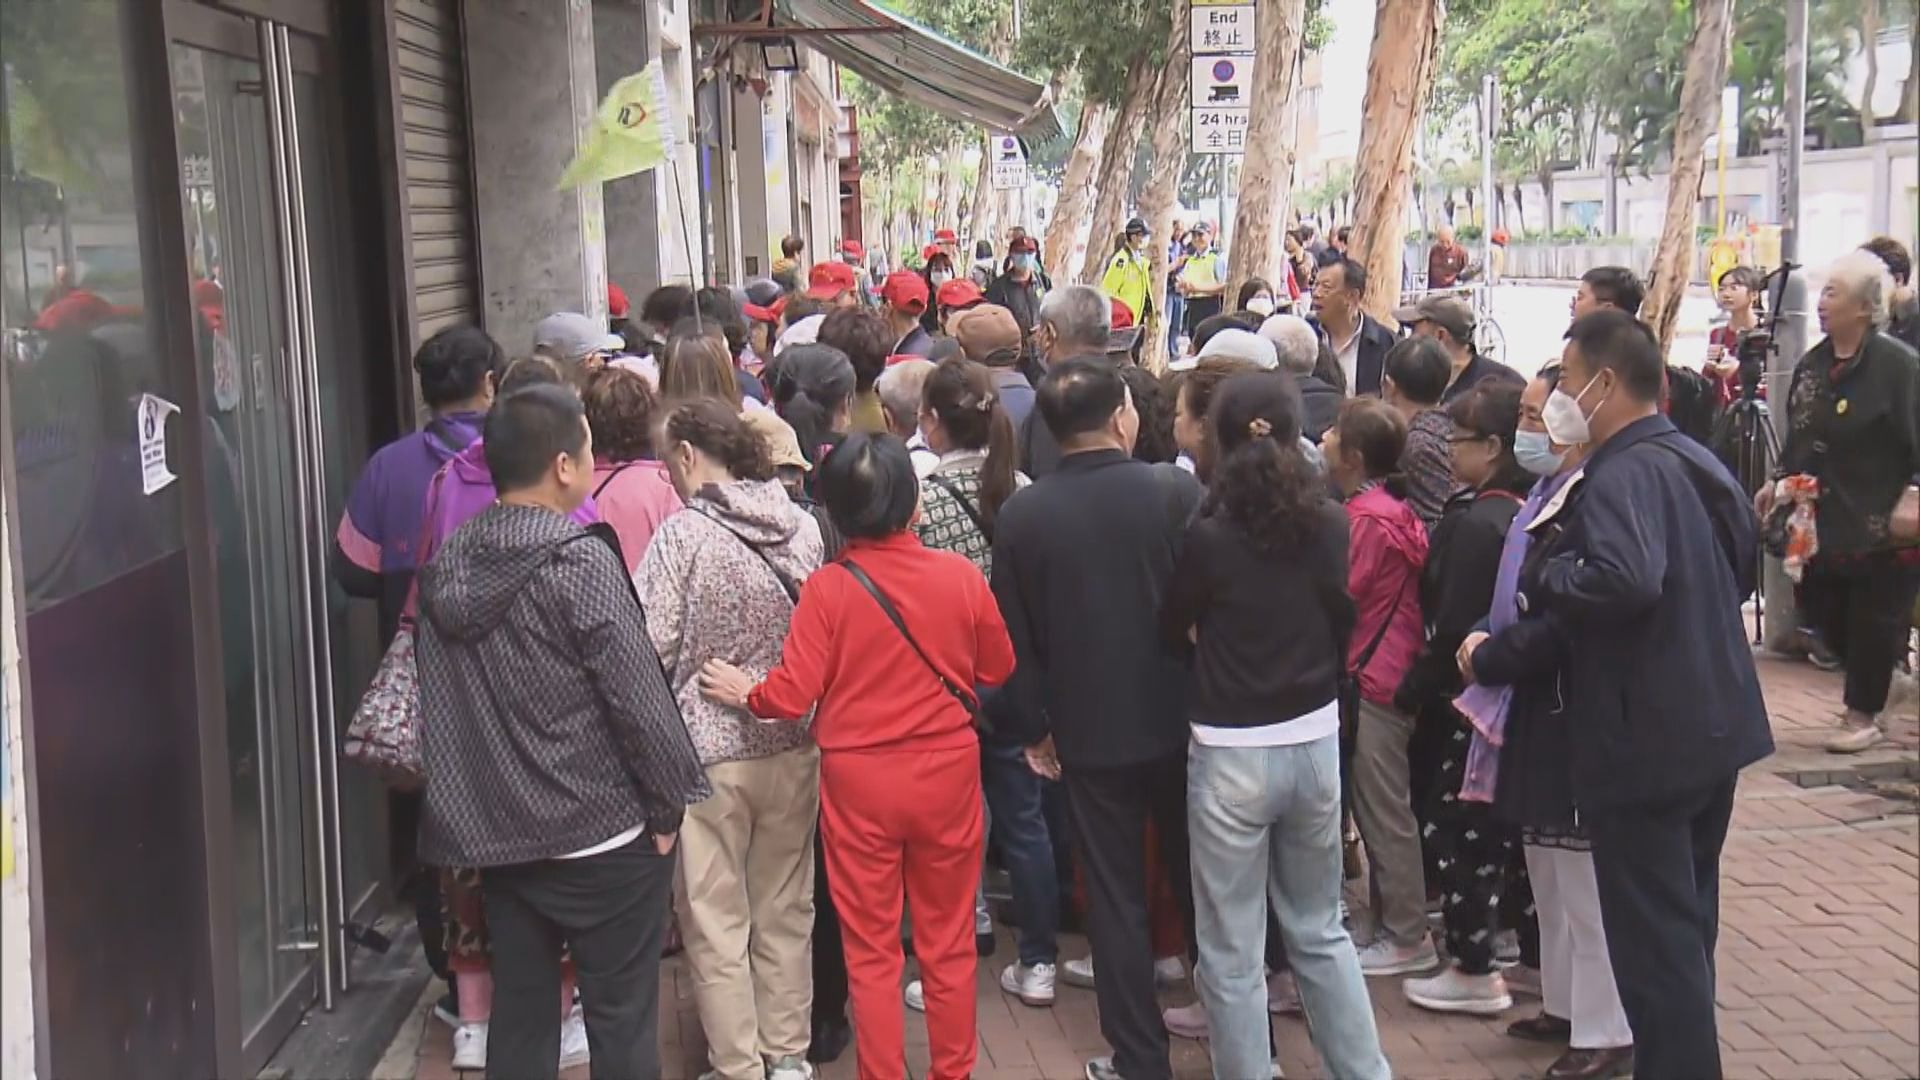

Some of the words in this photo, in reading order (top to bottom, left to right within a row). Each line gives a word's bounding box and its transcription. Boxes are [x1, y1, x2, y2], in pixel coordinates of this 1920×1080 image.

[1209, 10, 1238, 23] End
[1203, 28, 1243, 47] 終止
[1199, 113, 1220, 126] 24
[1225, 113, 1247, 125] hrs
[1206, 130, 1242, 147] 全日
